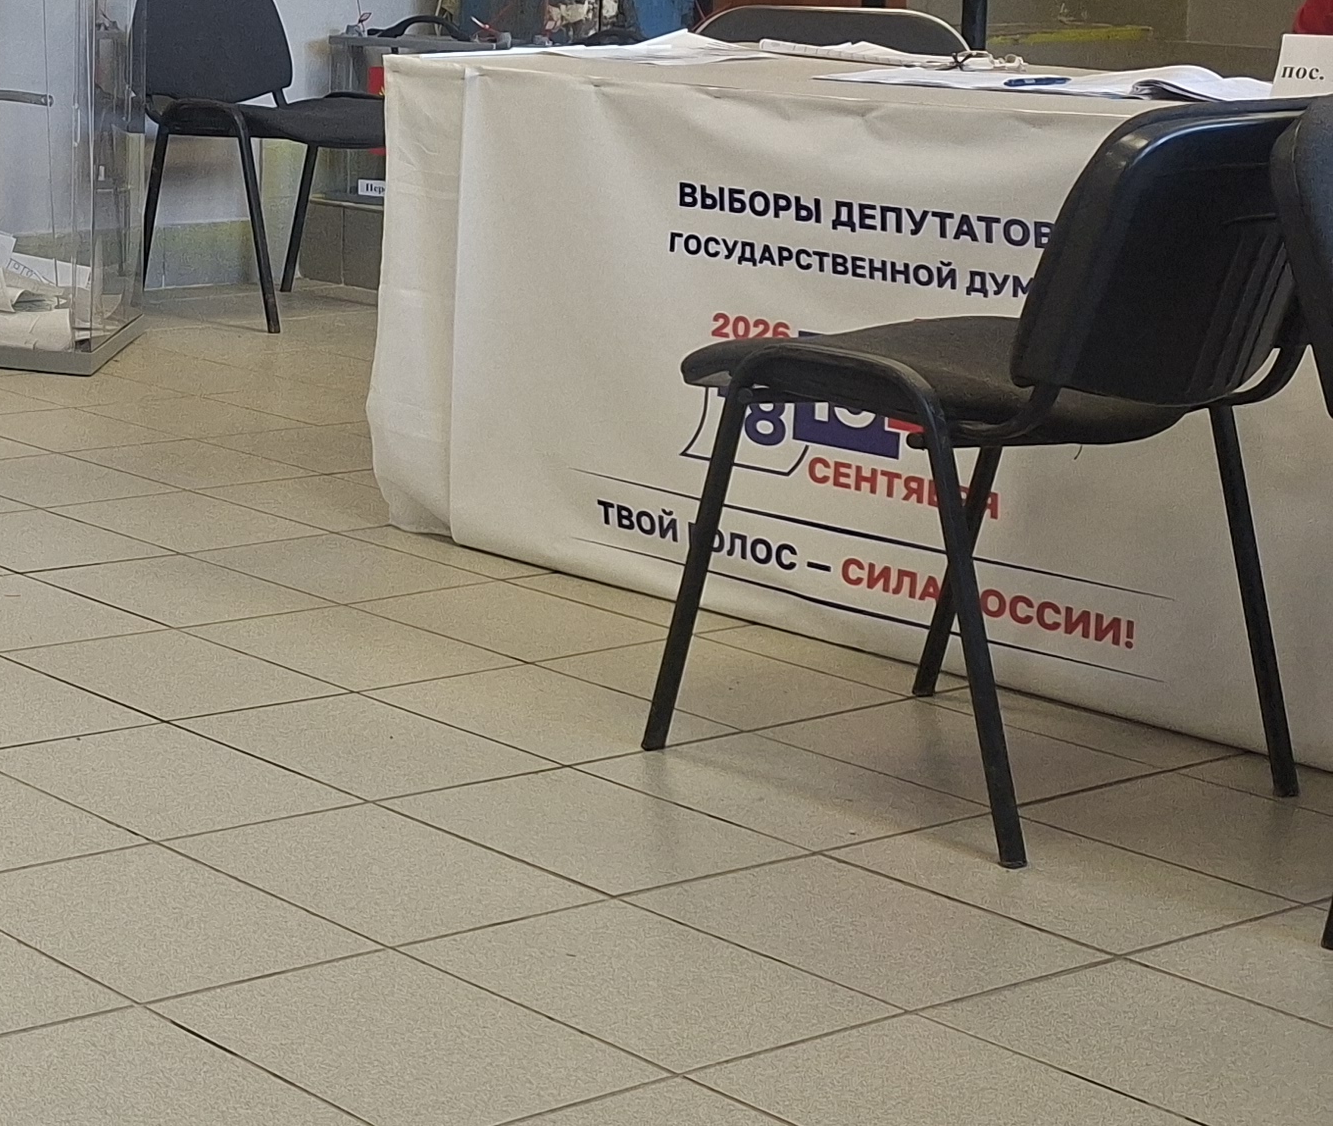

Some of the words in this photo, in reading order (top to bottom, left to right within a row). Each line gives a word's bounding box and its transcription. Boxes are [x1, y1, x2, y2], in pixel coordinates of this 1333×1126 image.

[1281, 66, 1324, 80] пос.
[366, 183, 385, 194] Пер
[678, 181, 822, 224] ВЫБОРЫ
[832, 200, 1055, 250] ДЕПУТАТОВ
[668, 232, 957, 291] ГОСУДАРСТВЕННОЙ
[964, 270, 1034, 299] ДУМ
[711, 312, 791, 339] 2026
[597, 499, 679, 544] ТВОЙ
[840, 557, 942, 602] СИЛА
[981, 587, 1135, 650] ОССИИ!
